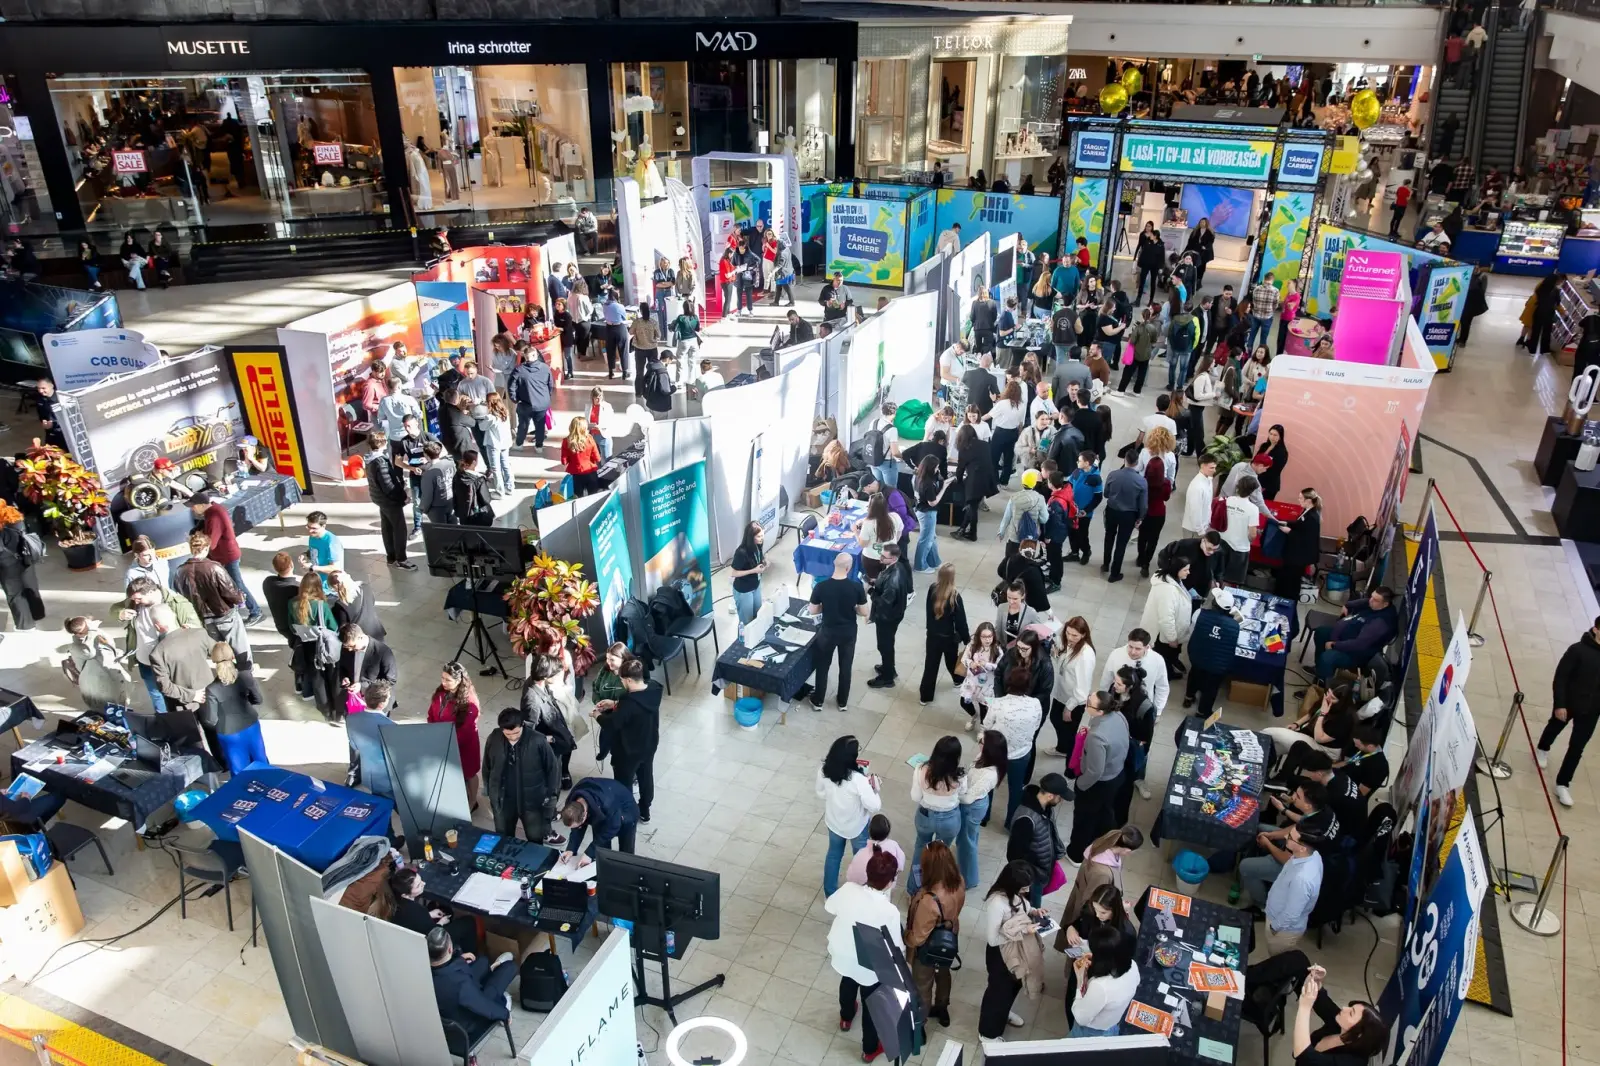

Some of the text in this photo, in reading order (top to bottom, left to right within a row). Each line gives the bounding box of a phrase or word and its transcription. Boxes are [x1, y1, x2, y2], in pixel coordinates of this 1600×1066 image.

[167, 40, 250, 54] MUSETTE
[478, 41, 531, 54] schrotter
[695, 31, 758, 52] MAD
[934, 35, 993, 50] TEILOR
[1068, 68, 1087, 80] ZARA
[317, 153, 340, 162] SALE
[118, 160, 144, 169] SALE
[984, 195, 1009, 210] INFO
[980, 209, 1014, 224] POINT
[847, 234, 877, 245] TÂRGUL
[847, 242, 880, 254] CARIERE
[1348, 264, 1396, 275] futurenet
[90, 356, 118, 367] CQB
[1325, 370, 1345, 378] IULIUS
[136, 385, 156, 399] what
[181, 374, 190, 383] us
[104, 401, 144, 419] CONTROL
[151, 391, 171, 403] what
[171, 385, 188, 397] gets
[188, 382, 197, 391] us
[246, 364, 296, 477] PIRELLI
[183, 450, 217, 471] JOURNEY
[651, 484, 675, 497] Leading
[652, 496, 665, 505] way
[672, 487, 684, 496] safe
[686, 481, 697, 491] and
[652, 494, 686, 512] transparent
[652, 507, 677, 520] markets
